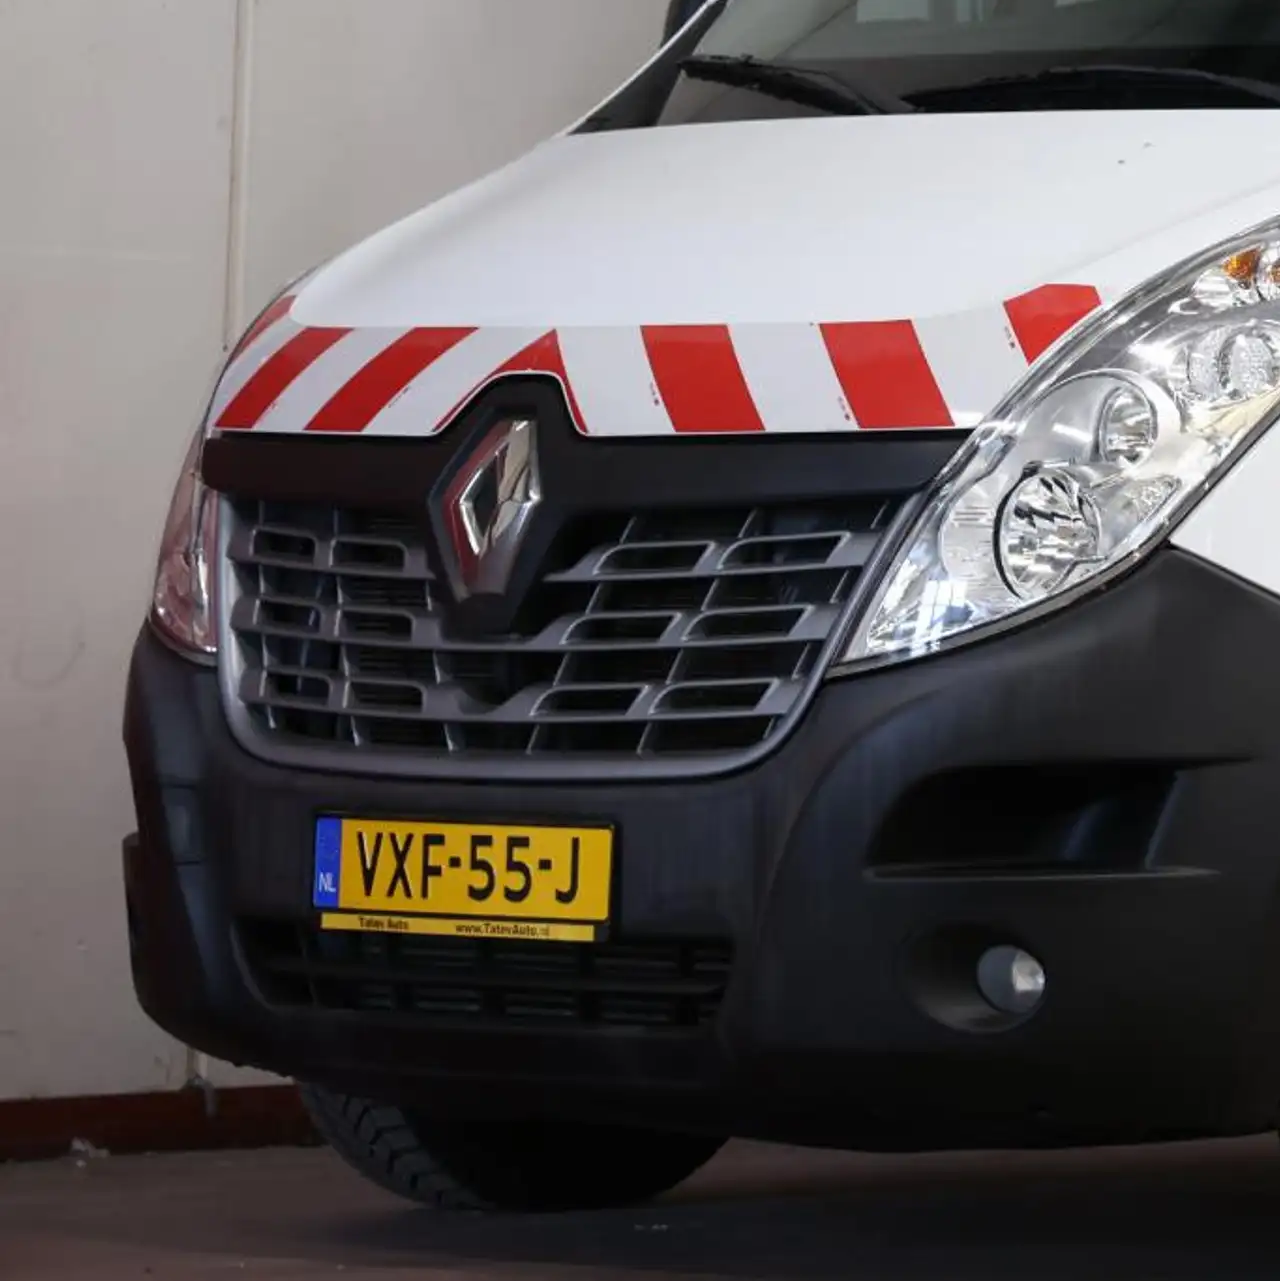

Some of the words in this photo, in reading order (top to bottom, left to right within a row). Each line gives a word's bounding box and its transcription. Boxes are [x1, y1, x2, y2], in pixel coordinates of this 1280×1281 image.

[357, 831, 580, 904] VXF-55-J
[319, 872, 337, 893] NL
[387, 917, 410, 931] Auto
